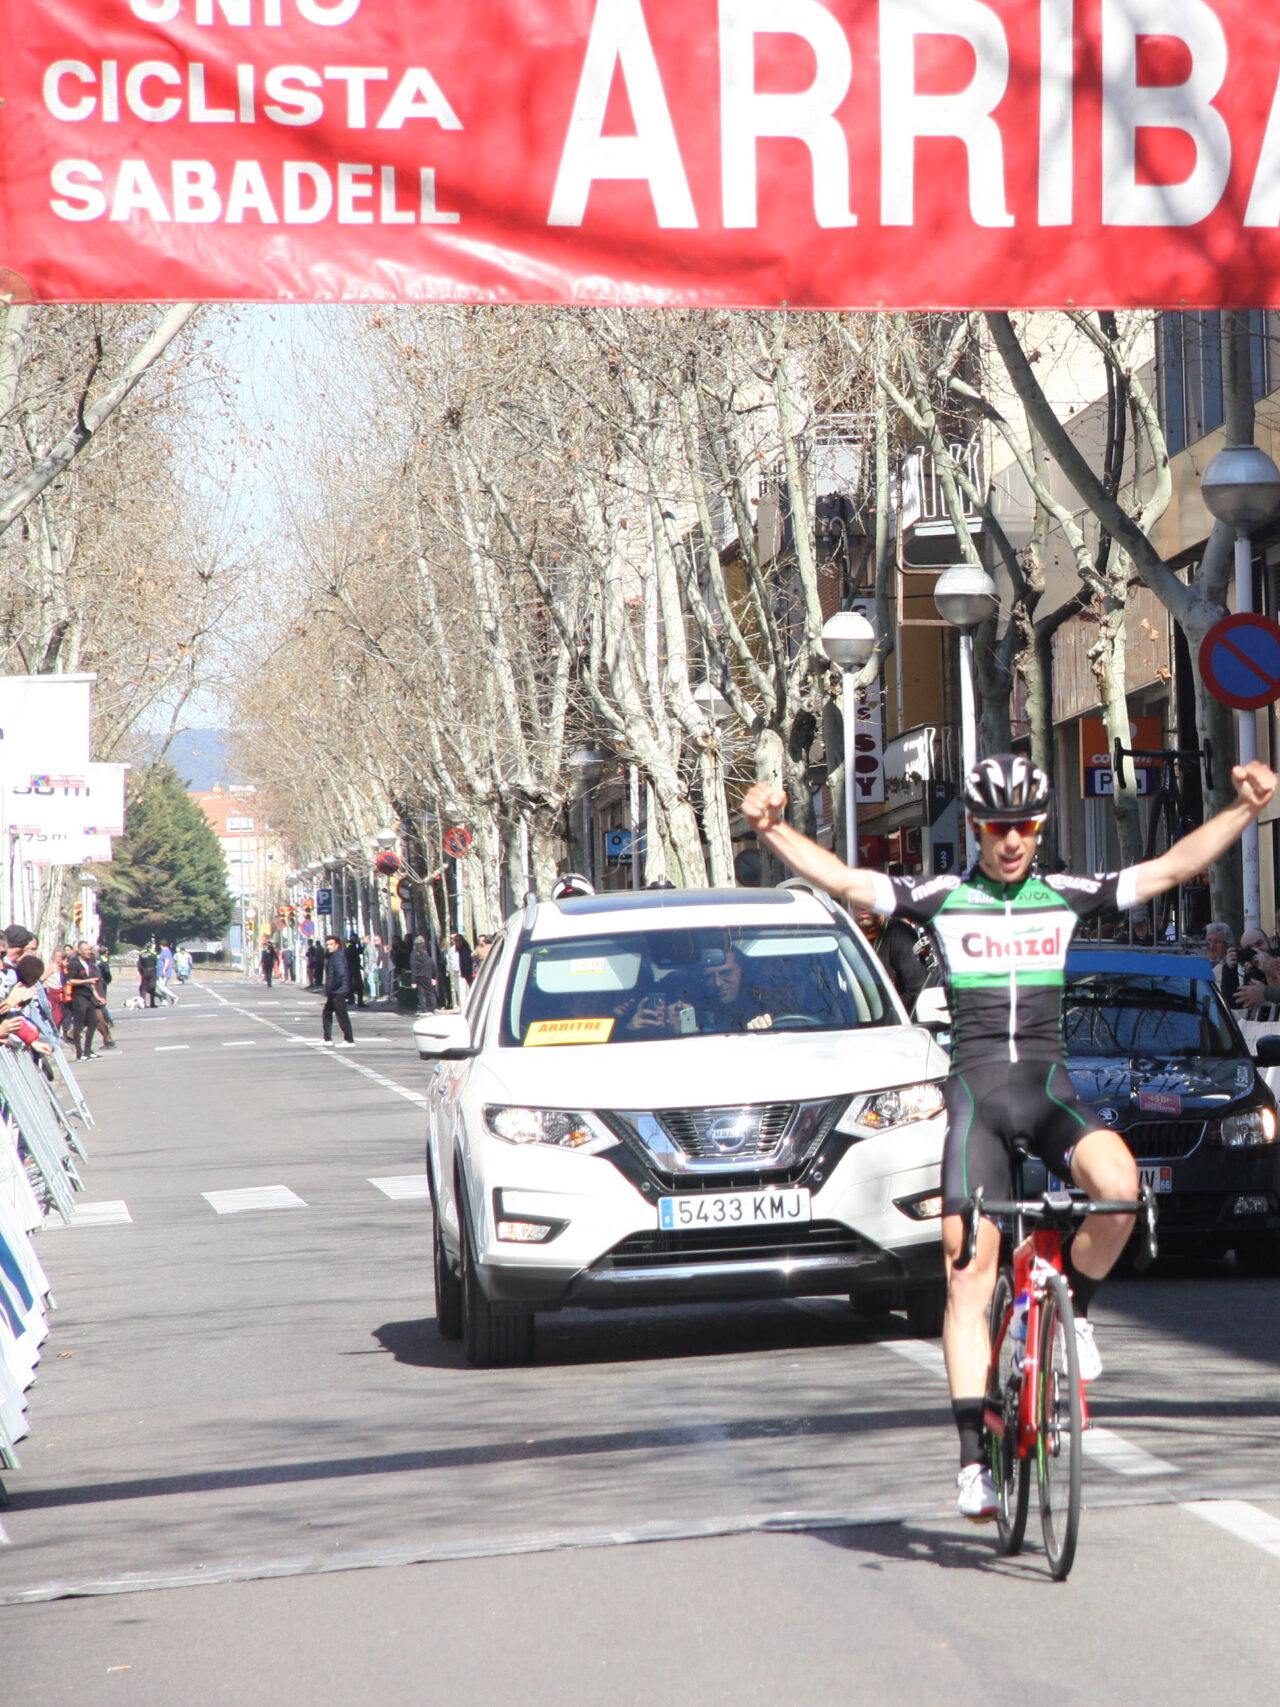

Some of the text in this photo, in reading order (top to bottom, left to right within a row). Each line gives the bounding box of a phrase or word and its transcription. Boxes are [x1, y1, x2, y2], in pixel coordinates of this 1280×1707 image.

[43, 60, 465, 130] CICLISTA
[50, 158, 461, 224] SABADELL
[961, 926, 1061, 959] Chazal
[538, 1020, 604, 1033] ARBITRE
[678, 1198, 743, 1224] 5433
[753, 1194, 801, 1220] KMJ
